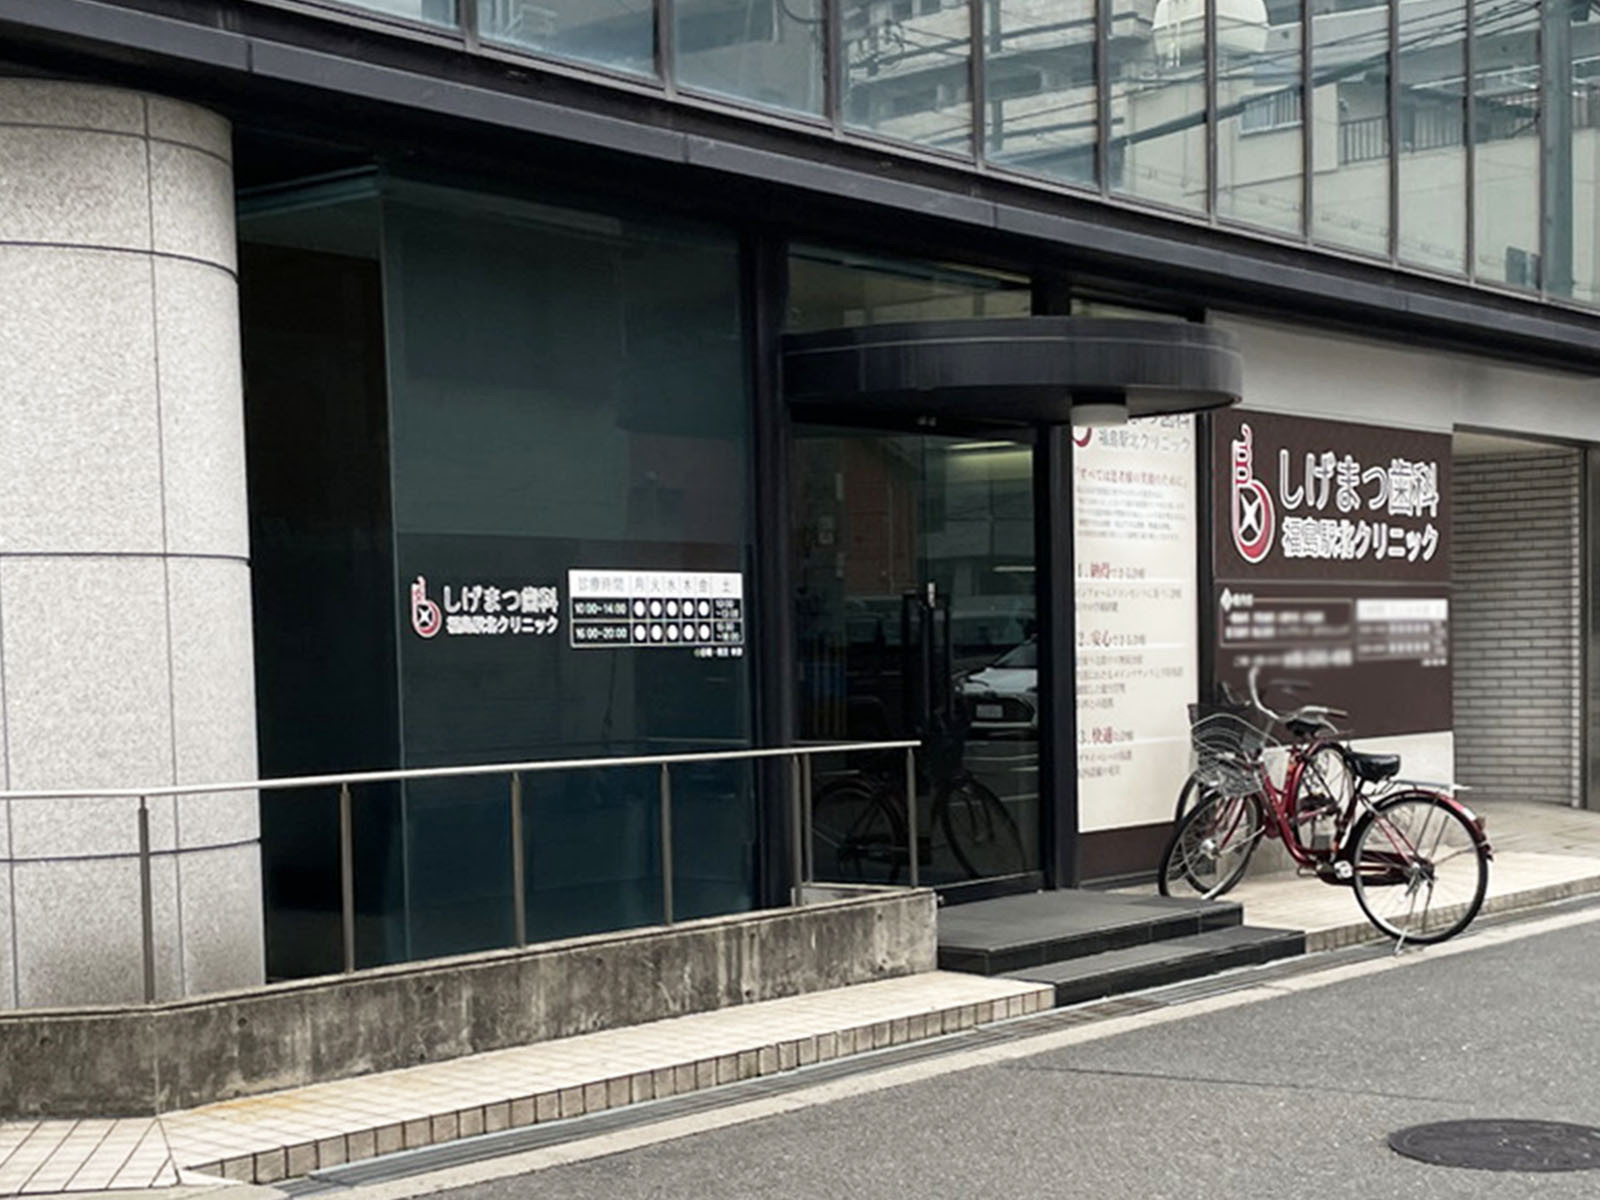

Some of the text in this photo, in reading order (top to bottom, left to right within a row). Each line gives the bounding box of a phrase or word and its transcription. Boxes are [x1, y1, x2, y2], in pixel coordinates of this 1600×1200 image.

[1279, 449, 1439, 518] しげまつ歯科
[443, 585, 558, 614] しげまつ歯科
